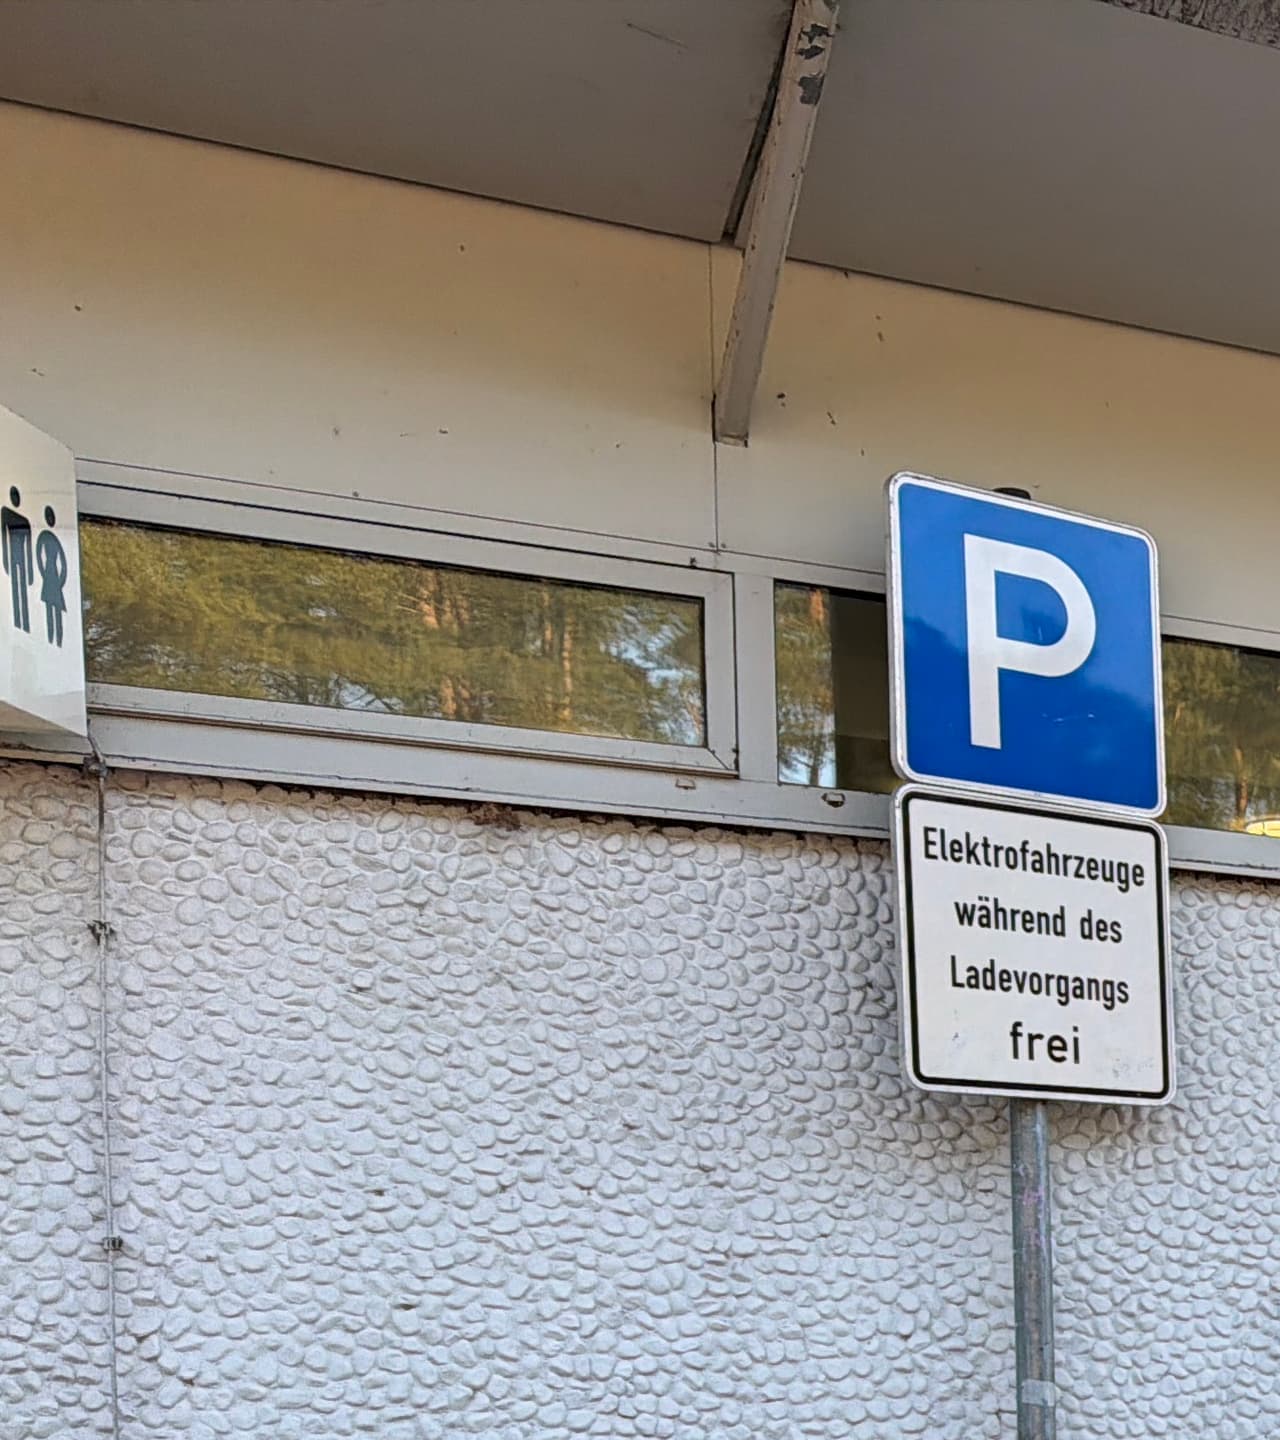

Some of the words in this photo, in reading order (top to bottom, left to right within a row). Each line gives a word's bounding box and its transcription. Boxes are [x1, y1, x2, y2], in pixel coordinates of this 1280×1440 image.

[964, 533, 1097, 750] P
[923, 826, 1146, 892] Elektrofahrzeuge
[954, 896, 1067, 938] während
[1079, 911, 1123, 944] des
[949, 954, 1130, 1011] Ladevorgangs
[1009, 1021, 1081, 1065] frei
